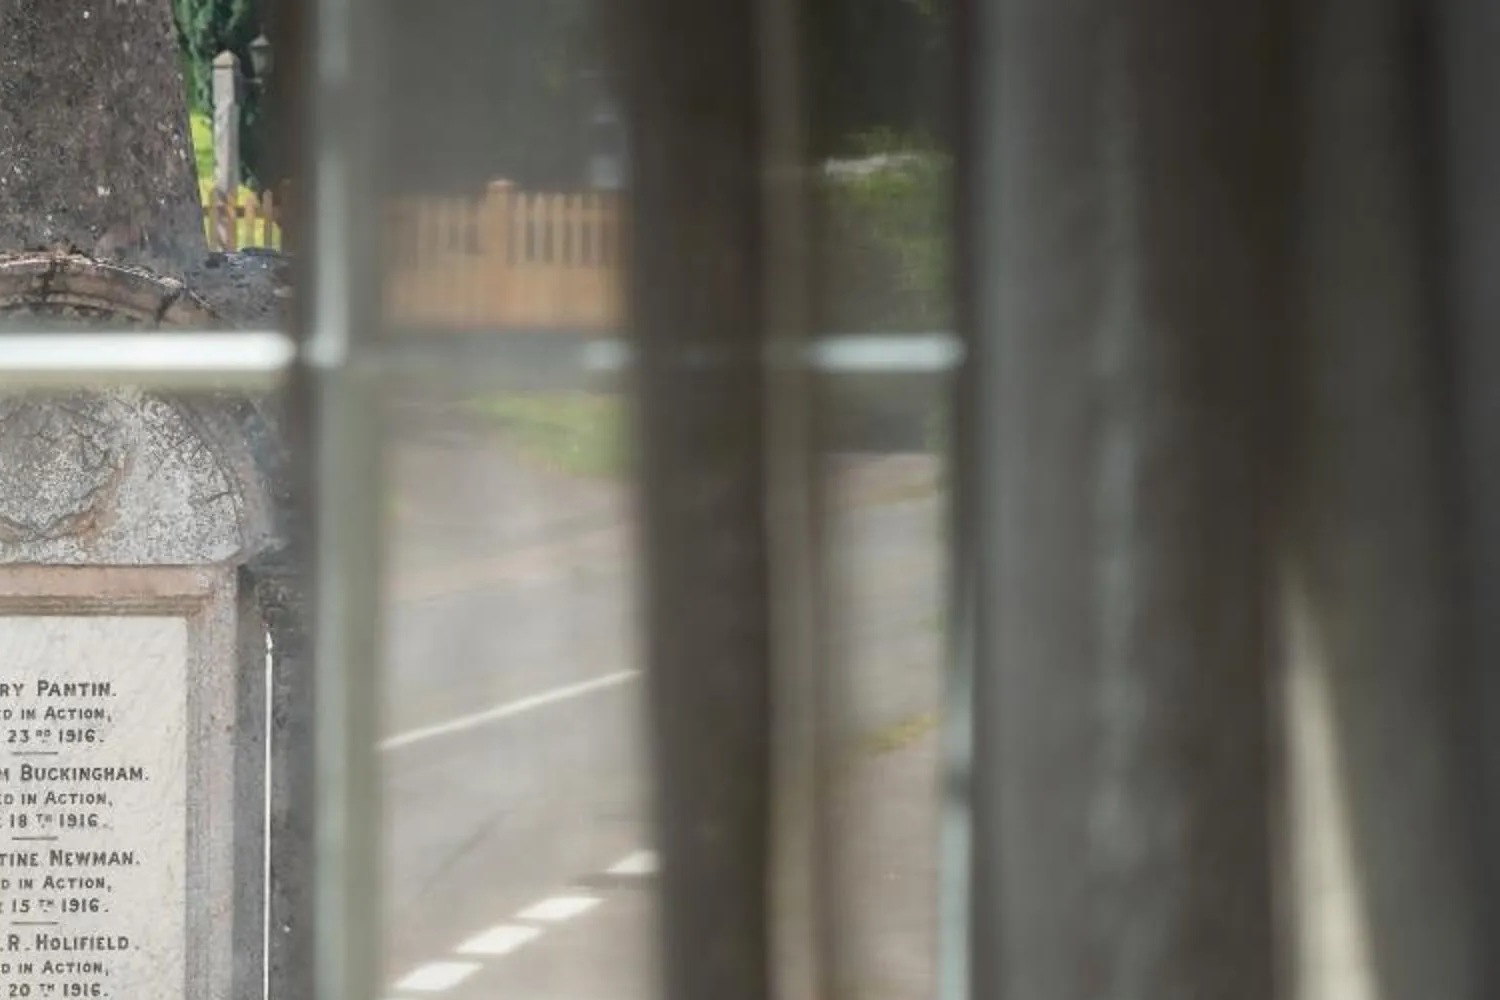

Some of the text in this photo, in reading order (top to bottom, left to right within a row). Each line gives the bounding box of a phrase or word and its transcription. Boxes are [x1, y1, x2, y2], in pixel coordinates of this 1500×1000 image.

[37, 680, 117, 697] PANTIN.
[22, 709, 35, 720] IN
[44, 707, 112, 722] ACTION,
[59, 730, 104, 742] 1916.
[21, 765, 149, 781] BUCKINGHAM.
[22, 794, 37, 805] IN
[44, 792, 112, 807] ACTION,
[60, 814, 107, 828] 1916.
[50, 850, 140, 866] NEWMAN.
[19, 878, 33, 889] IN
[43, 876, 111, 892] ACTION,
[61, 899, 109, 912] 1916.
[36, 934, 139, 951] HOLIFIELD.
[19, 963, 33, 974] IN
[42, 961, 109, 976] ACTION,
[63, 983, 108, 997] 1916.
